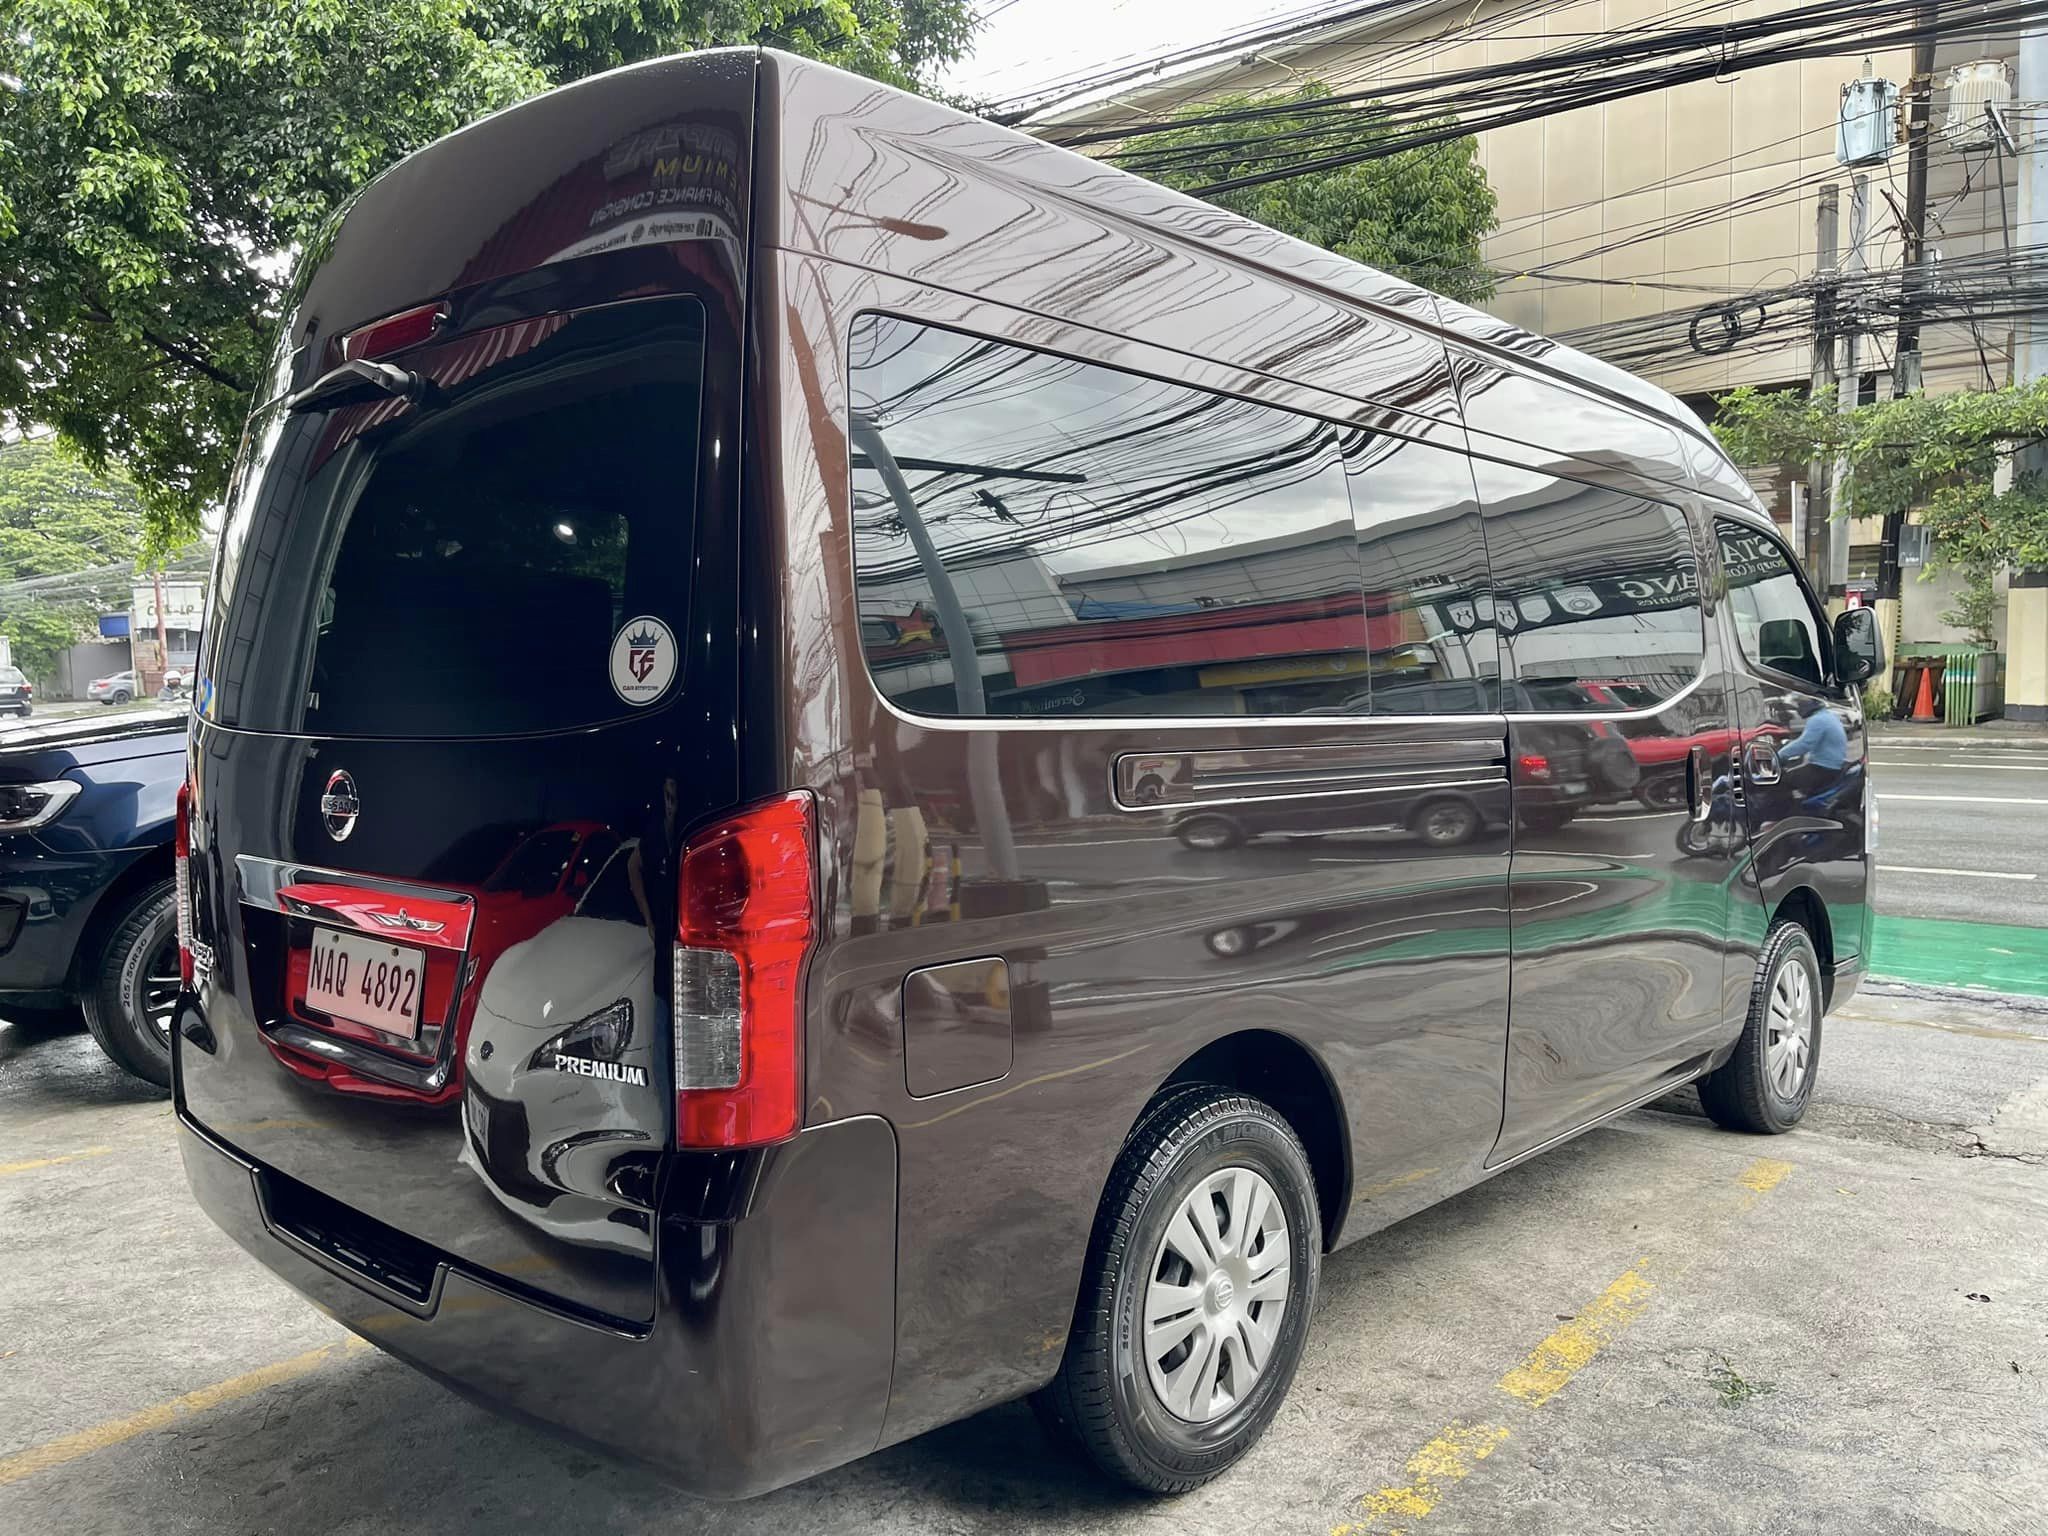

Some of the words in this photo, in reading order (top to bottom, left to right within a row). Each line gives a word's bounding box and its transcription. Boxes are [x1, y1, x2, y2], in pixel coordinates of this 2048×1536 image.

[310, 945, 349, 998] NAQ
[361, 958, 416, 1018] 4892
[554, 1053, 646, 1087] PREMIUM
